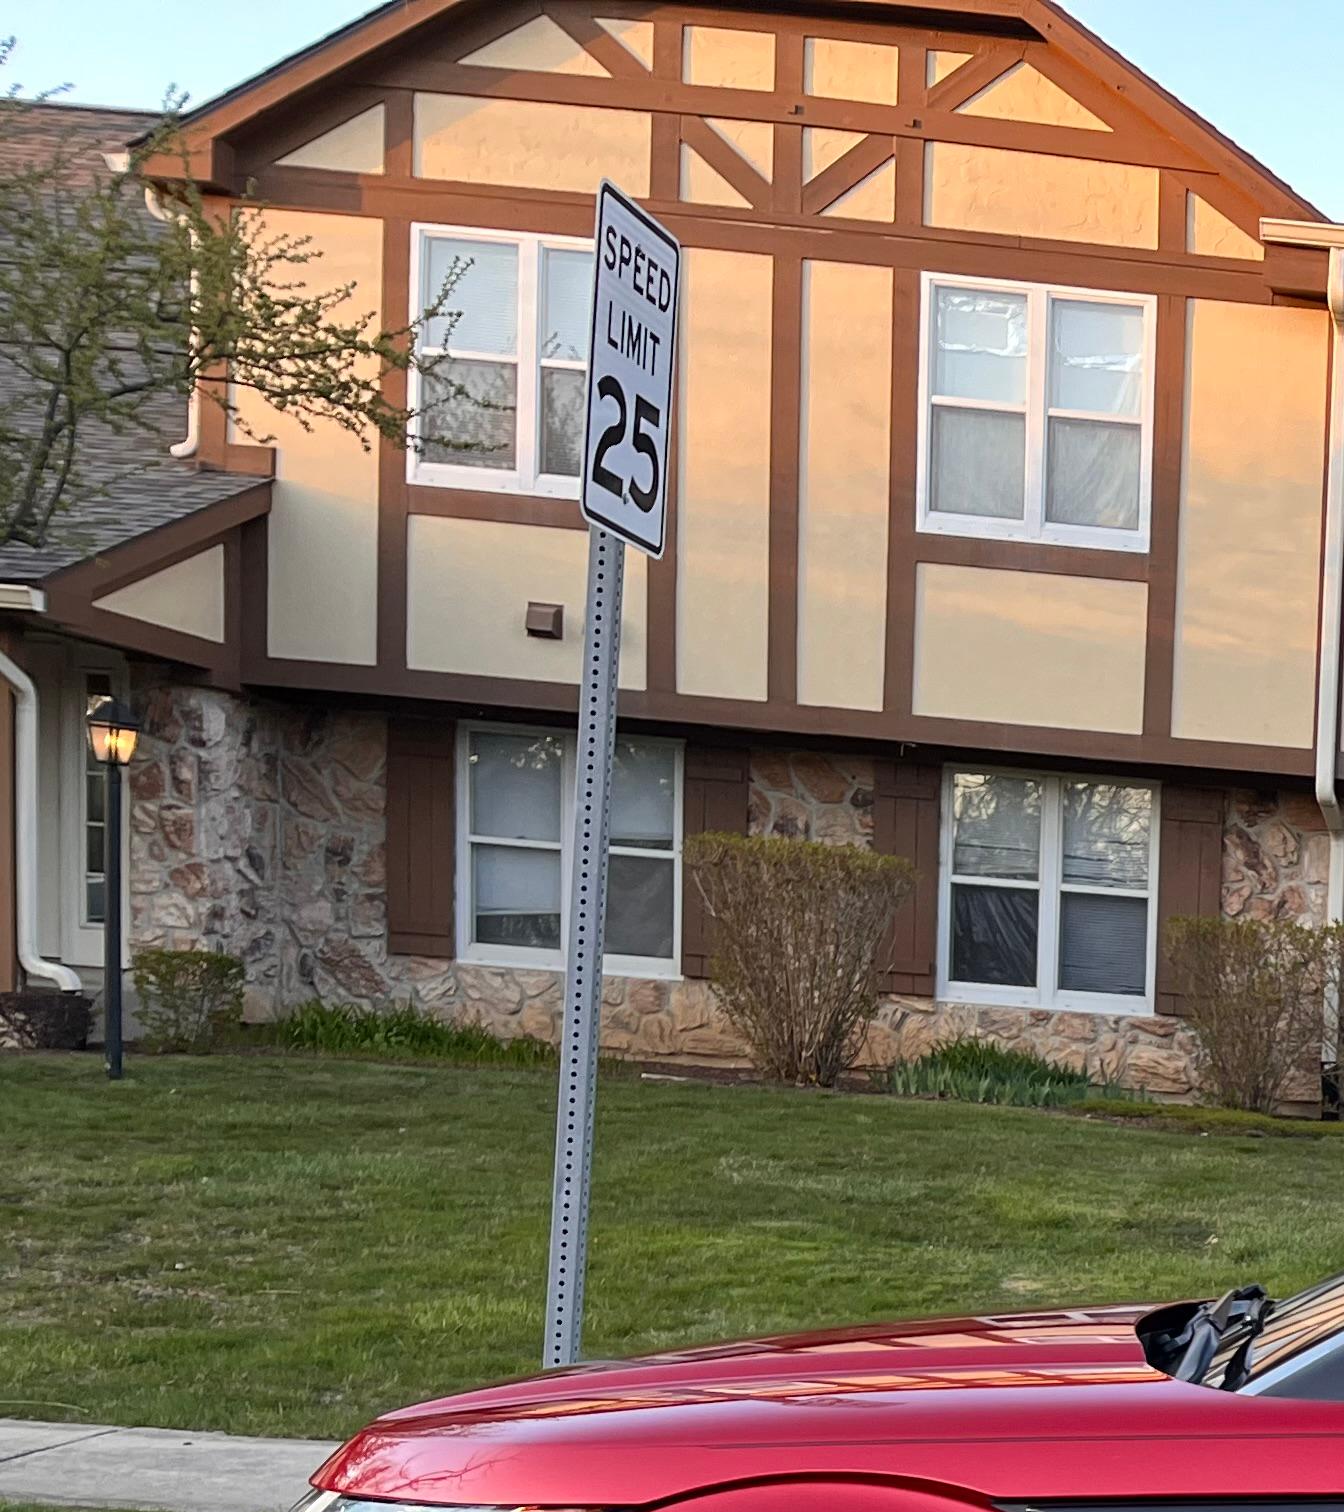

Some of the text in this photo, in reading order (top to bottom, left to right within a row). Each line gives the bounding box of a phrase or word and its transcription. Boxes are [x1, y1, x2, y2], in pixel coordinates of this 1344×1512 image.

[604, 225, 671, 313] SPEED
[607, 300, 661, 376] LIMIT
[592, 375, 661, 513] 25
